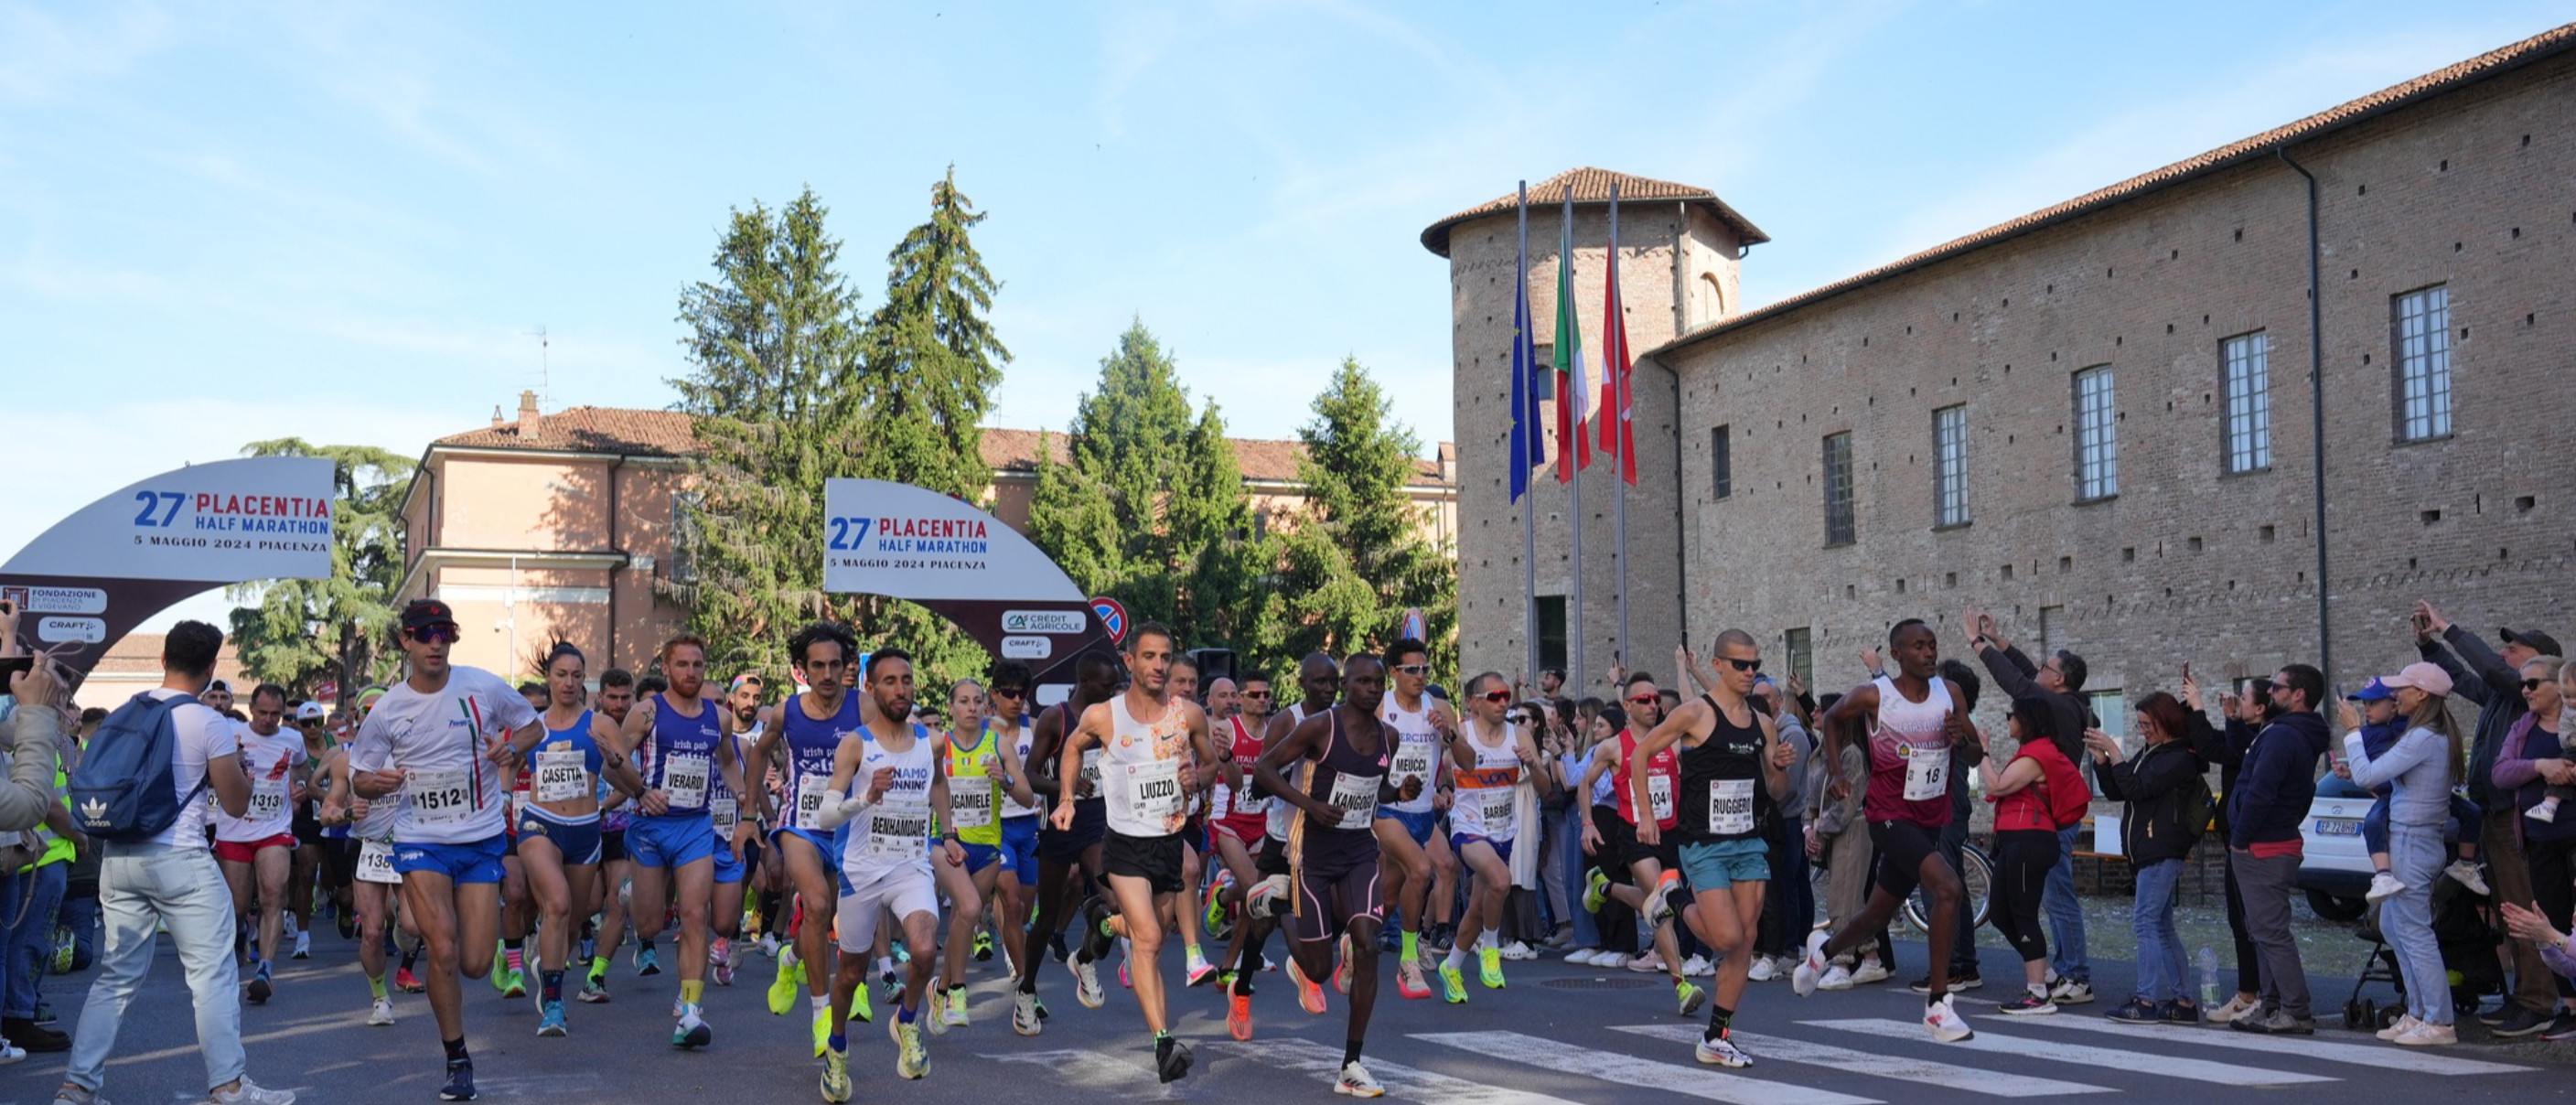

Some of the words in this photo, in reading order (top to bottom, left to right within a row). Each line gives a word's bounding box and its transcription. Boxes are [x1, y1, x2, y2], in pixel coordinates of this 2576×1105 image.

[134, 490, 186, 527] 27
[197, 493, 328, 519] PLACENTIA
[196, 517, 236, 531] HALF
[242, 519, 328, 534] MARATHON
[830, 517, 871, 551] 27
[880, 518, 987, 538] PLACENTIA
[134, 535, 142, 545] 5
[150, 536, 207, 548] MAGGIO
[214, 539, 252, 549] 2024
[259, 541, 327, 552] PIACENZA
[879, 539, 912, 552] HALF
[917, 540, 986, 553] MARATHON
[830, 559, 836, 567] 5
[843, 559, 888, 568] MAGGIO
[894, 560, 925, 568] 2024
[930, 561, 986, 569] PIACENZA
[32, 589, 97, 598] FONDAZIONE
[49, 621, 84, 629] CRAFT
[1030, 614, 1067, 623] CRÉDIT
[1030, 623, 1080, 631] AGRICOLE
[1399, 733, 1436, 743] ERCITO
[892, 768, 928, 778] NAMO
[1396, 757, 1427, 772] MEUCCI
[542, 767, 582, 784] CASETTA
[669, 773, 704, 790] VERARDI
[1926, 767, 1939, 785] 18
[1140, 778, 1175, 799] LIUZZO
[252, 793, 280, 807] 1313
[419, 788, 461, 810] 1512
[1334, 791, 1375, 811] KANGOGO
[1712, 797, 1751, 814] RUGGIERO
[84, 820, 112, 828] adidas
[871, 816, 927, 837] BENHAMDANE
